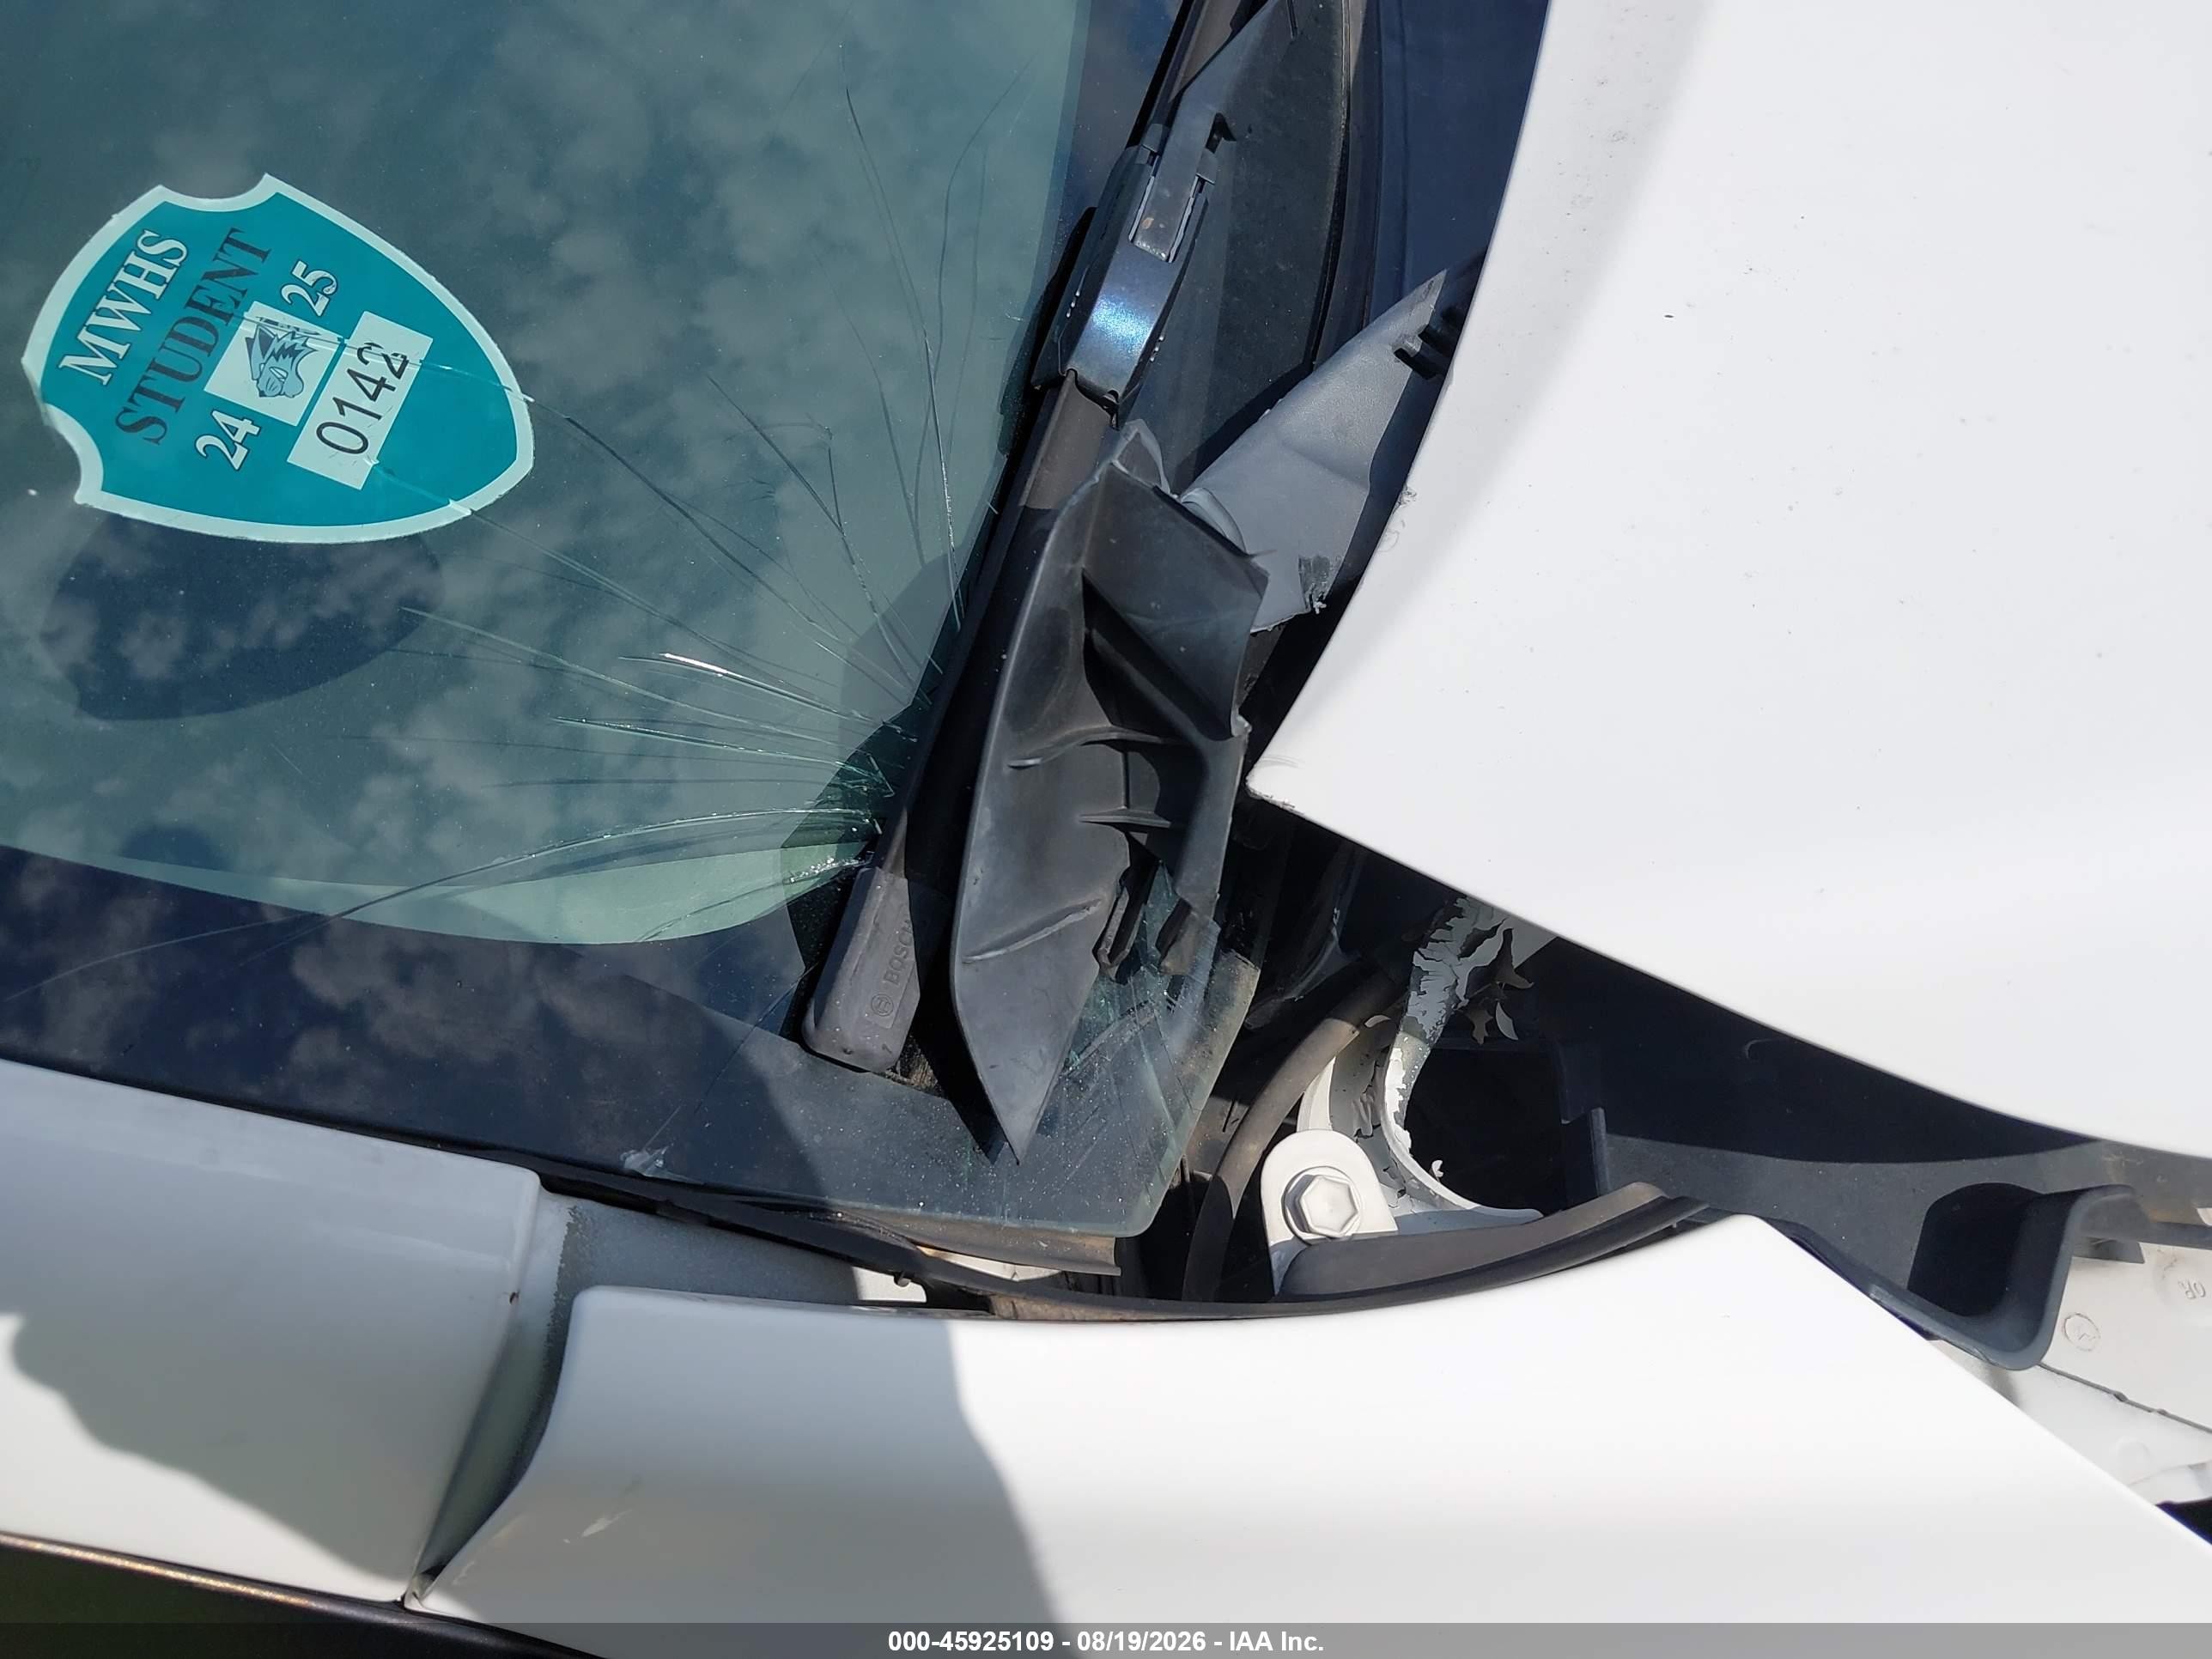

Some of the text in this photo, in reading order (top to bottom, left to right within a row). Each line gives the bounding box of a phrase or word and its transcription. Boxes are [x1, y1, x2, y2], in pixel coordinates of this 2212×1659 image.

[59, 229, 189, 386] MWHS
[115, 228, 271, 445] STUDENT
[195, 259, 338, 471] 24 25
[316, 341, 409, 455] 0142
